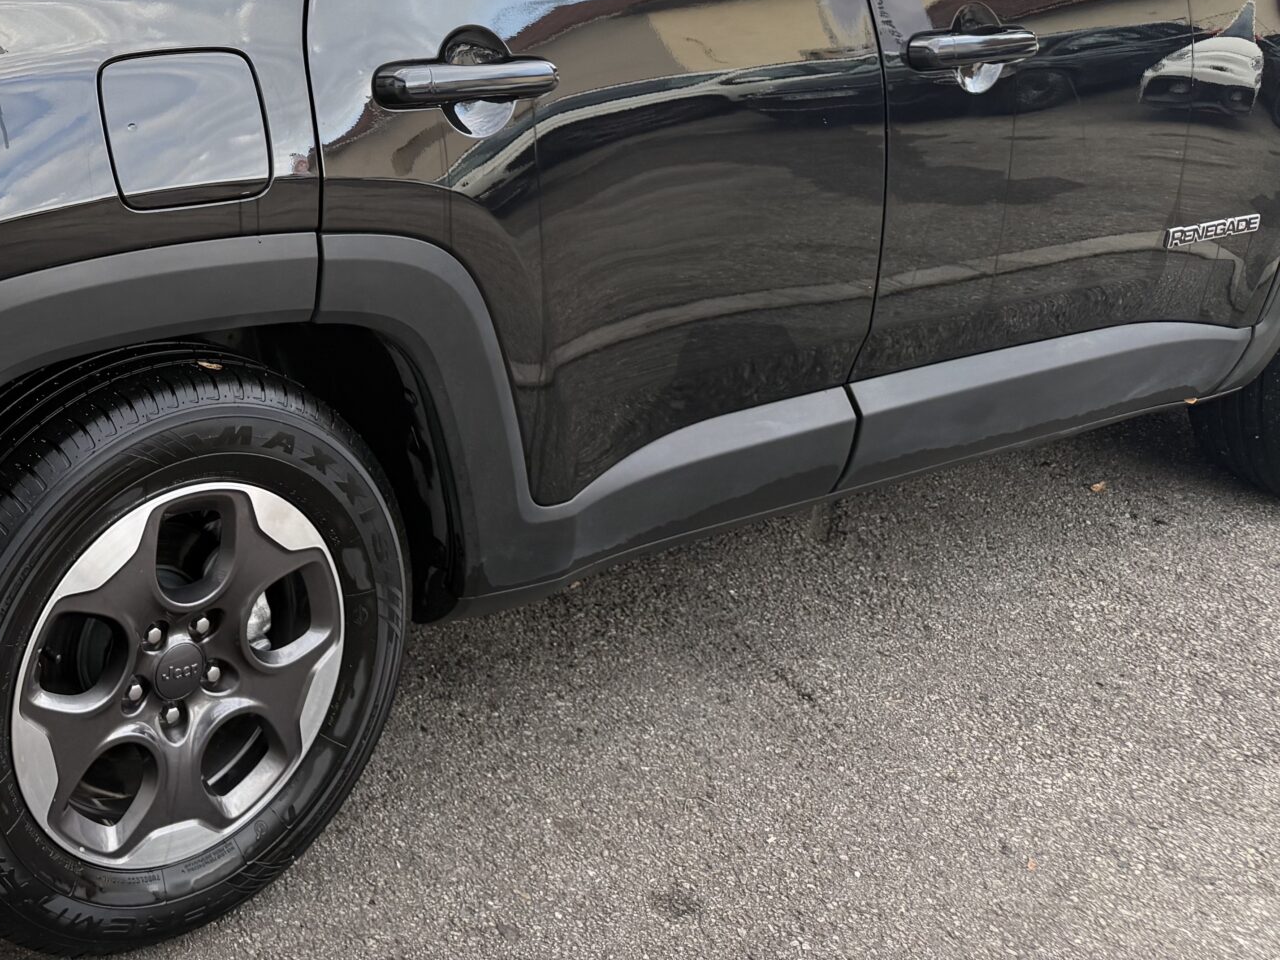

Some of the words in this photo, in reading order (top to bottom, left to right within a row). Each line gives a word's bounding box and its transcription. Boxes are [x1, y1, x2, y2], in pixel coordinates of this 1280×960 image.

[1167, 213, 1261, 249] RENEGADE
[213, 424, 390, 564] MAXXIS
[161, 662, 198, 680] Jeep
